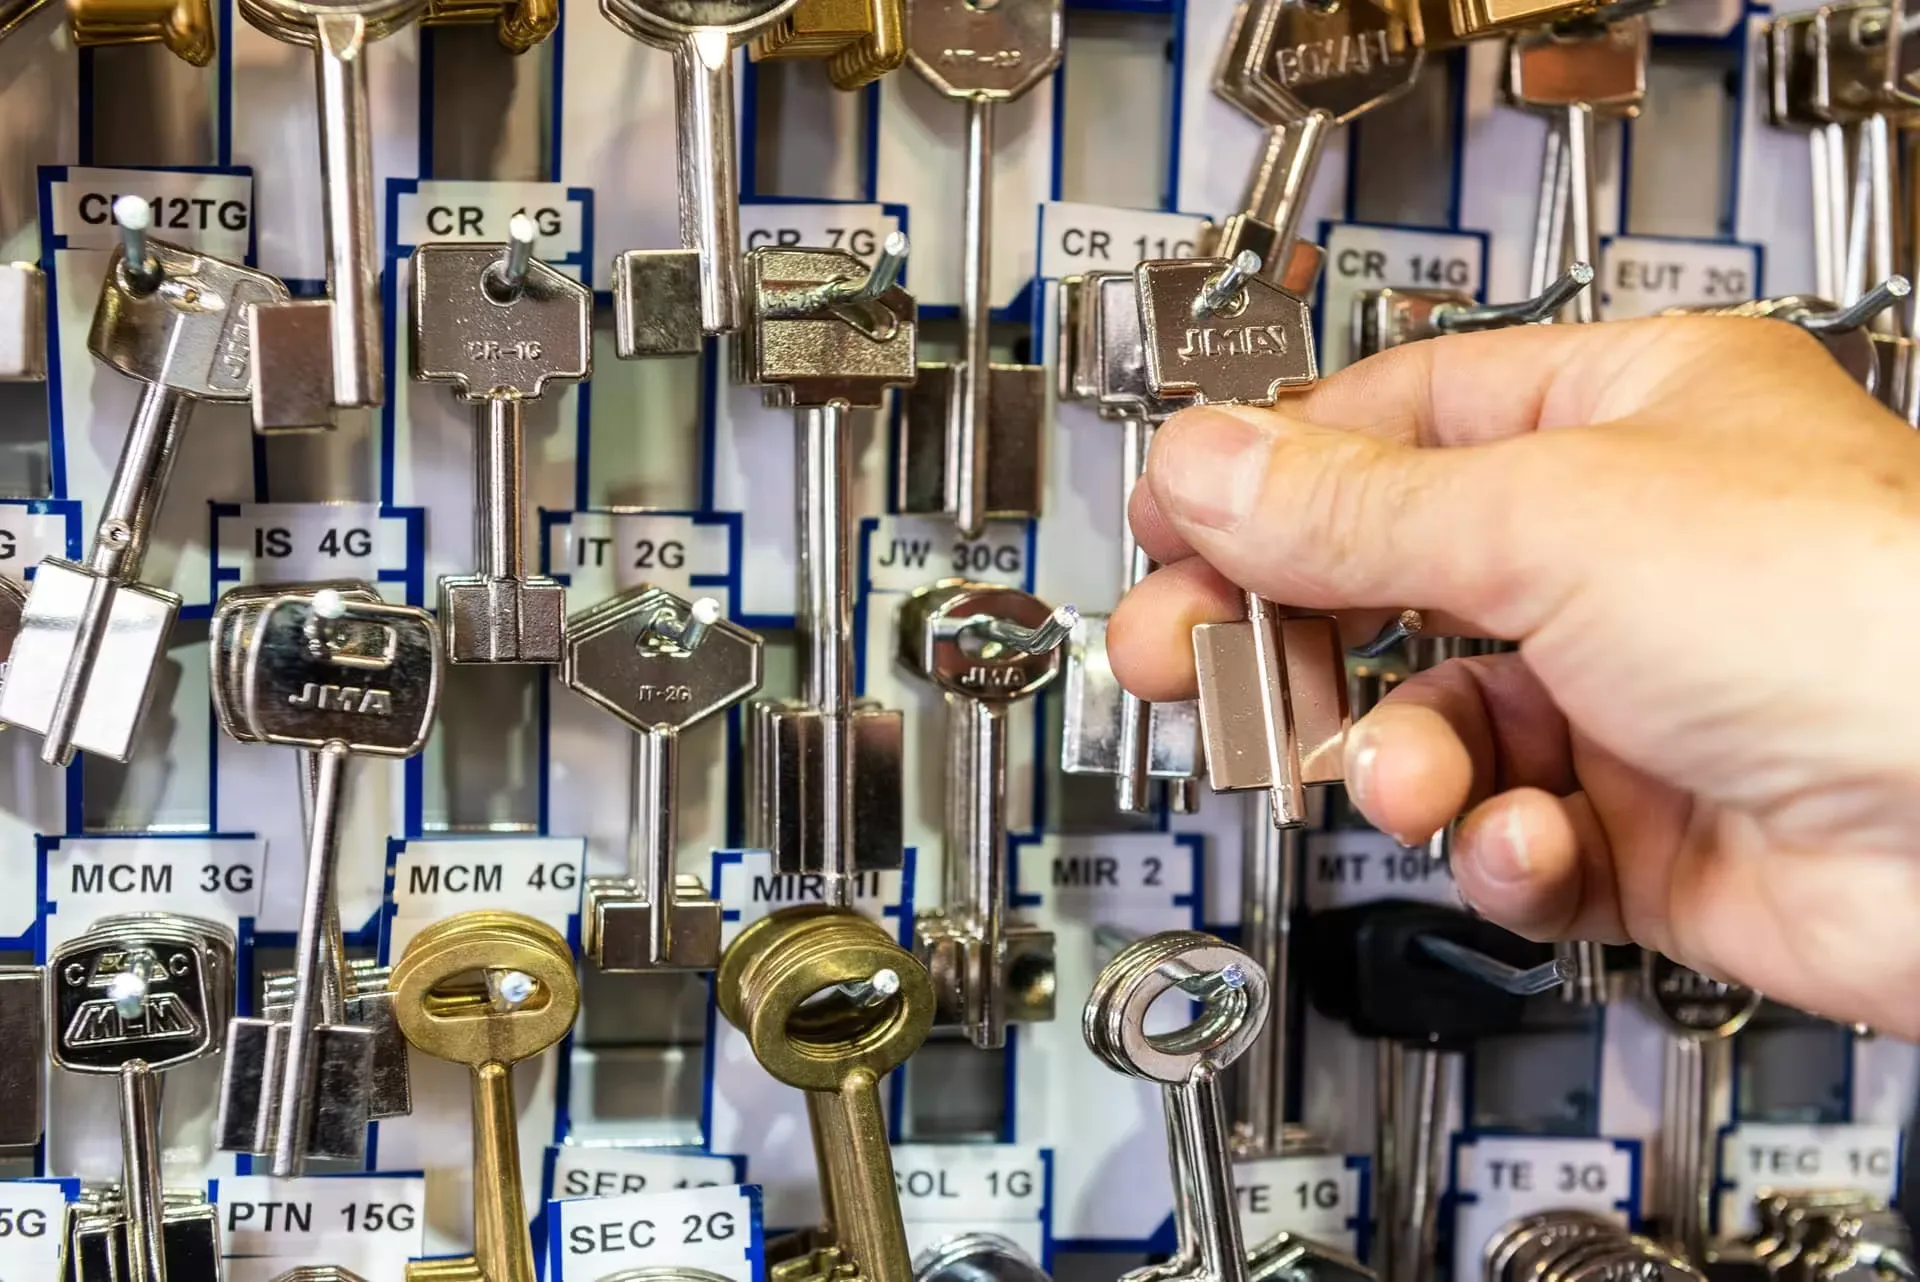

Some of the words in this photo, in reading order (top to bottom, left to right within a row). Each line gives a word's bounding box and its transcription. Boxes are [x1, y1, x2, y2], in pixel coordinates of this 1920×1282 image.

[427, 206, 484, 236] CR
[826, 229, 876, 256] 7G
[1062, 229, 1111, 260] CR
[1338, 249, 1386, 280] CR
[1410, 255, 1469, 285] 14G
[1617, 260, 1685, 292] EUT
[1704, 267, 1746, 295] 2G
[1177, 325, 1288, 360] JMA
[255, 528, 292, 558] IS
[318, 528, 372, 557] 4G
[577, 537, 612, 567] IT
[634, 540, 685, 569] 2G
[879, 540, 931, 568] JW
[952, 543, 1020, 573] 30G
[288, 682, 392, 715] JMA
[638, 684, 693, 703] IT-2G
[72, 864, 173, 893] MCM
[200, 864, 254, 893] 3G
[409, 863, 503, 894] MCM
[527, 862, 577, 891] 4G
[1052, 857, 1119, 886] MIR
[1142, 857, 1163, 886] 2
[1318, 854, 1369, 883] MT
[753, 873, 823, 902] MIR
[985, 1170, 1033, 1198] 1G
[1488, 1160, 1532, 1191] TE
[1558, 1163, 1608, 1193] 3G
[1295, 1179, 1340, 1209] 1G
[228, 1202, 313, 1233] PTN
[340, 1203, 415, 1233] 15G
[569, 1219, 656, 1255] SEC
[683, 1211, 735, 1244] 2G
